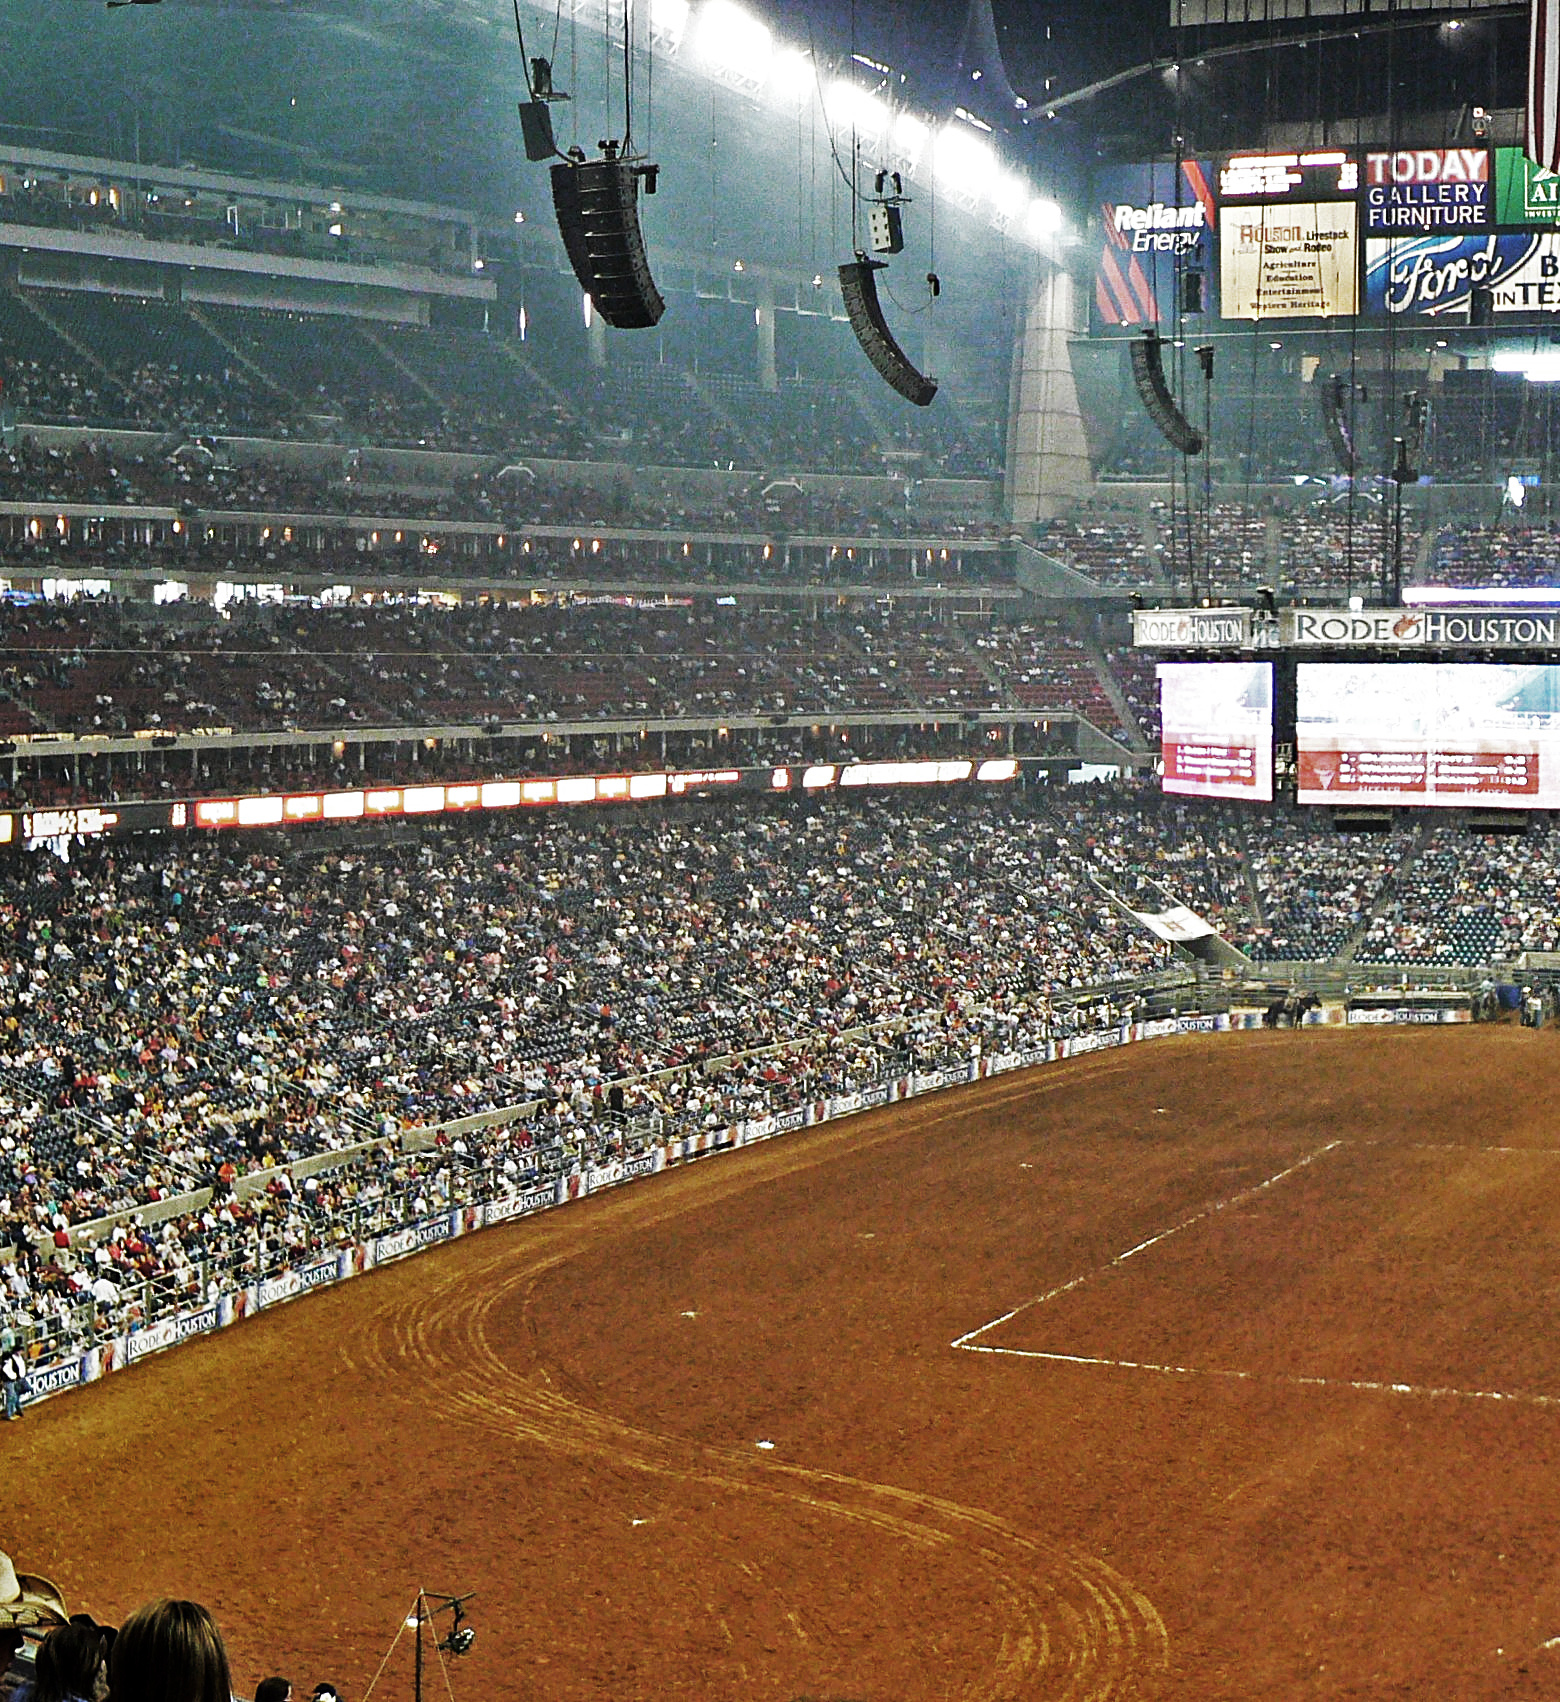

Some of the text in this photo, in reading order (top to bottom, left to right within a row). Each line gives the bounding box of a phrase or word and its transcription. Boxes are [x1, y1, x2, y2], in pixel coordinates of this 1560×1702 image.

[1367, 150, 1486, 183] TODAY
[1370, 184, 1486, 206] GALLERY
[1113, 201, 1207, 232] Reliant
[1369, 205, 1486, 227] FURNITURE
[1131, 228, 1201, 255] Energy
[1306, 230, 1349, 241] Livestock
[1264, 243, 1288, 254] Show
[1303, 242, 1333, 254] Rodeo
[1263, 260, 1317, 270] Agriculture
[1384, 235, 1503, 313] Ford
[1266, 273, 1314, 283] Education
[1256, 286, 1325, 297] Entertainment
[1496, 291, 1516, 306] IN
[1425, 611, 1556, 643] HOUSTON
[174, 1310, 217, 1340] HOUSTON
